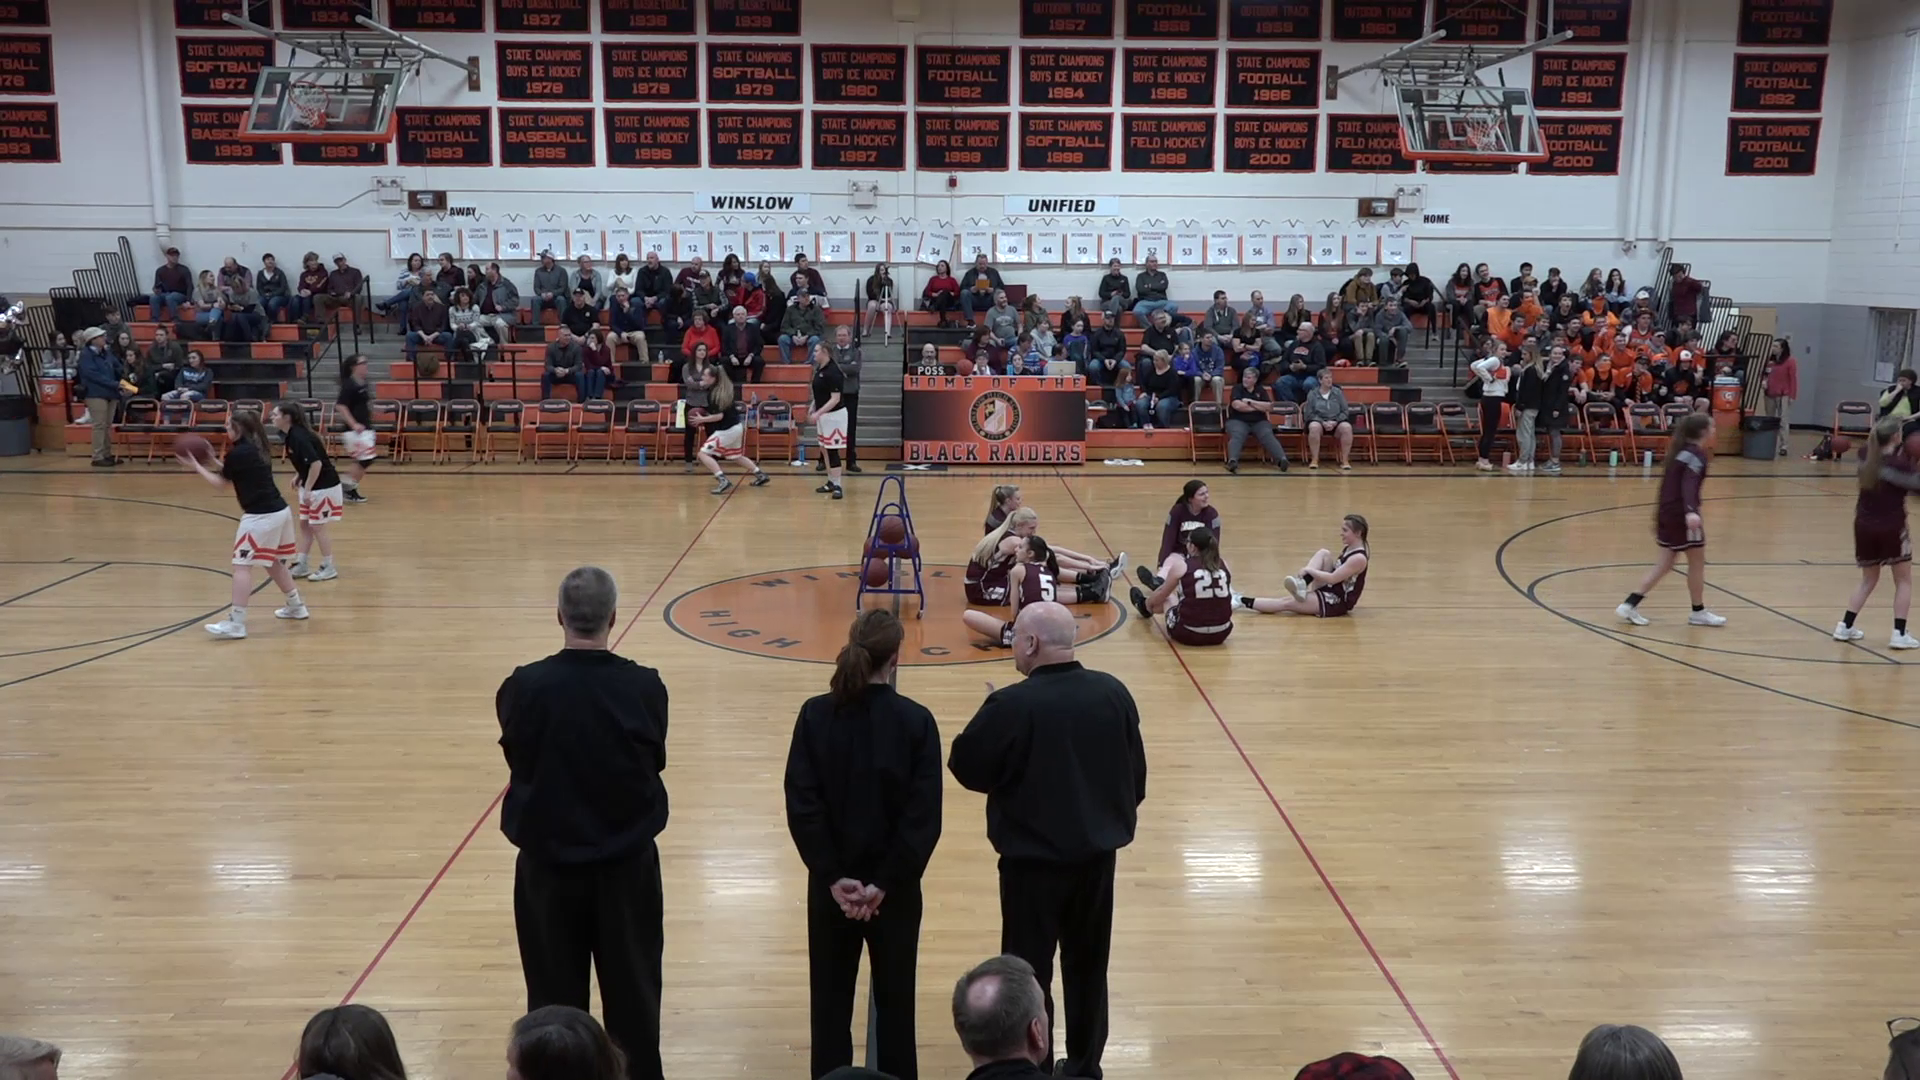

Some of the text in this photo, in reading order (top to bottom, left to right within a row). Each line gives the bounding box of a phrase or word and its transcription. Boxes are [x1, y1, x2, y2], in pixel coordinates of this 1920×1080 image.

[1137, 4, 1206, 15] FOOTBALL
[523, 14, 561, 26] 1937
[1752, 12, 1818, 22] FOOTBALL
[188, 45, 264, 56] STATE CHAMPIONS
[506, 50, 581, 60] STATE CHAMPIONS
[612, 51, 687, 61] STATE CHAMPIONS
[717, 52, 792, 63] STATE CHAMPIONS
[822, 52, 896, 63] STATE CHAMPIONS
[926, 54, 1000, 65] STATE CHAMPIONS
[1030, 55, 1104, 66] STATE CHAMPIONS
[1133, 56, 1207, 67] STATE CHAMPIONS
[1237, 57, 1310, 68] STATE CHAMPIONS
[1543, 60, 1616, 71] STATE CHAMPIONS
[1744, 62, 1817, 73] STATE CHAMPIONS
[506, 66, 581, 77] BOYS ICE HOCKEY
[613, 67, 687, 78] BOYS ICE HOCKEY
[713, 68, 795, 78] SOFTBALL
[823, 69, 896, 80] BOYS ICE HOCKEY
[928, 70, 997, 81] FOOTBALL
[1030, 71, 1103, 82] BOYS ICE HOCKEY
[1133, 72, 1206, 84] BOYS ICE HOCKEY
[1239, 73, 1306, 84] FOOTBALL
[1542, 76, 1613, 87] BOYS ICE HOCKEY
[1745, 78, 1811, 88] FOOTBALL
[210, 78, 247, 90] 1977
[632, 83, 670, 94] 1979
[735, 84, 773, 95] 1979
[841, 85, 877, 96] 1980
[944, 87, 981, 98] 1982
[1048, 87, 1084, 98] 1984
[1561, 92, 1592, 103] 1991
[1760, 94, 1796, 104] 1992
[405, 115, 481, 126] STATE CHAMPIONS
[508, 116, 584, 126] STATE CHAMPIONS
[615, 117, 689, 127] STATE CHAMPIONS
[718, 117, 792, 128] STATE CHAMPIONS
[822, 119, 896, 130] STATE CHAMPIONS
[926, 120, 999, 131] STATE CHAMPIONS
[1029, 120, 1103, 131] STATE CHAMPIONS
[1132, 122, 1206, 132] STATE CHAMPIONS
[1234, 122, 1308, 133] STATE CHAMPIONS
[1567, 124, 1612, 135] CHAMPIONS
[1738, 126, 1810, 136] STATE CHAMPIONS
[408, 131, 479, 142] FOOTBALL
[507, 132, 587, 142] BASEBALL
[615, 132, 689, 144] BOYS ICE HOCKEY
[718, 133, 791, 144] BOYS ICE HOCKEY
[820, 135, 896, 146] FIELD HOCKEY
[926, 136, 999, 147] BOYS ICE HOCKEY
[1026, 136, 1105, 147] SOFTBALL
[1131, 137, 1206, 148] FIELD HOCKEY
[1234, 138, 1307, 149] BOYS ICE HOCKEY
[1336, 138, 1364, 148] FIELD
[1739, 141, 1805, 152] FOOTBALL
[214, 145, 253, 156] 1993
[321, 146, 358, 158] 1993
[426, 148, 463, 158] 1993
[737, 149, 774, 160] 1997
[1250, 154, 1290, 164] 2000
[1352, 154, 1392, 164] 2000
[1553, 156, 1593, 167] 2000
[1754, 157, 1789, 168] 2001
[712, 196, 793, 209] WINSLOW
[1028, 200, 1095, 212] UNIFIED
[449, 207, 476, 216] AWAY
[1424, 215, 1450, 224] HOME
[930, 248, 940, 256] 34
[1182, 248, 1192, 256] 53
[1253, 248, 1262, 256] 56
[1287, 248, 1297, 256] 57
[910, 378, 1081, 388] HOME OF THE
[909, 444, 1081, 461] BLACK RAIDERS
[1039, 574, 1055, 601] 5
[1194, 569, 1230, 598] 23
[699, 609, 802, 649] HIGH
